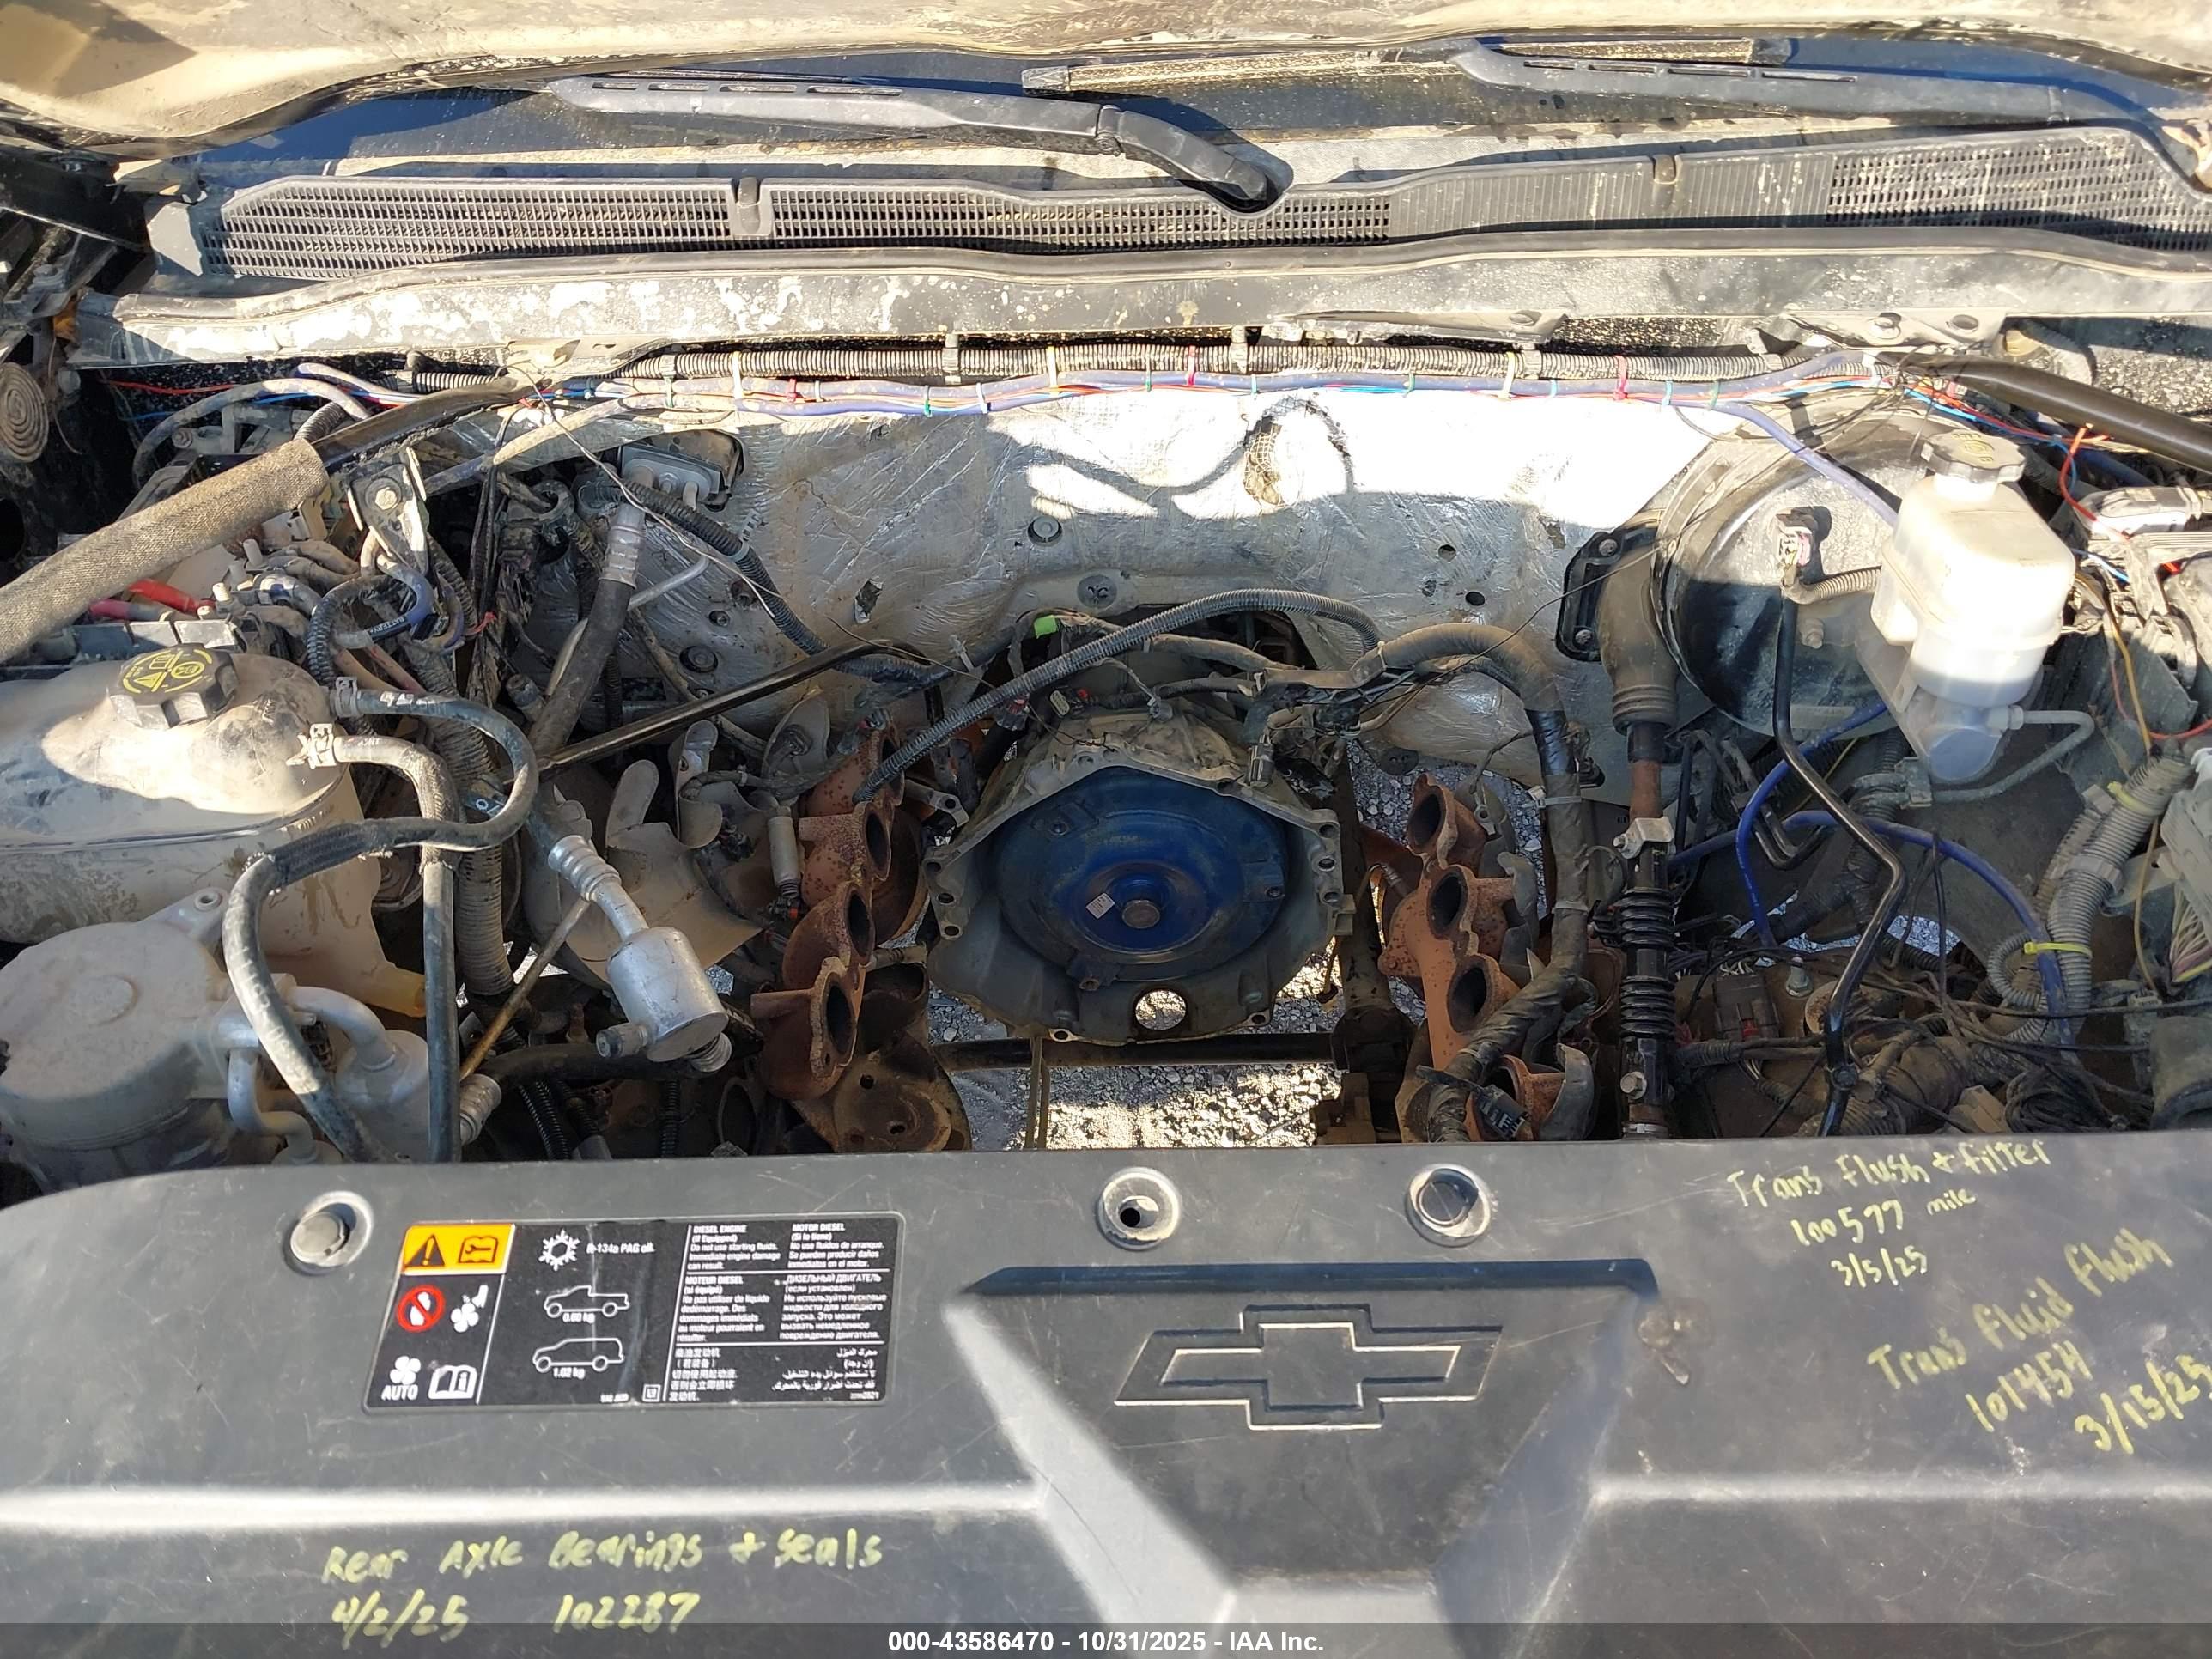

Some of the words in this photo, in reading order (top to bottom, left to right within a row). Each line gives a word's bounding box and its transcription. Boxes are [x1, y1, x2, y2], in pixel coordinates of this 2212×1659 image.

[1728, 1165, 1822, 1207] Trans
[621, 1243, 641, 1253] PAG
[1832, 1245, 1927, 1288] 3/5/25
[1868, 1326, 1966, 1390] Trans
[381, 1384, 418, 1401] AUTO
[549, 1530, 703, 1571] Bearings
[331, 1588, 468, 1650] 4/2/25
[553, 1591, 700, 1634] 102287
